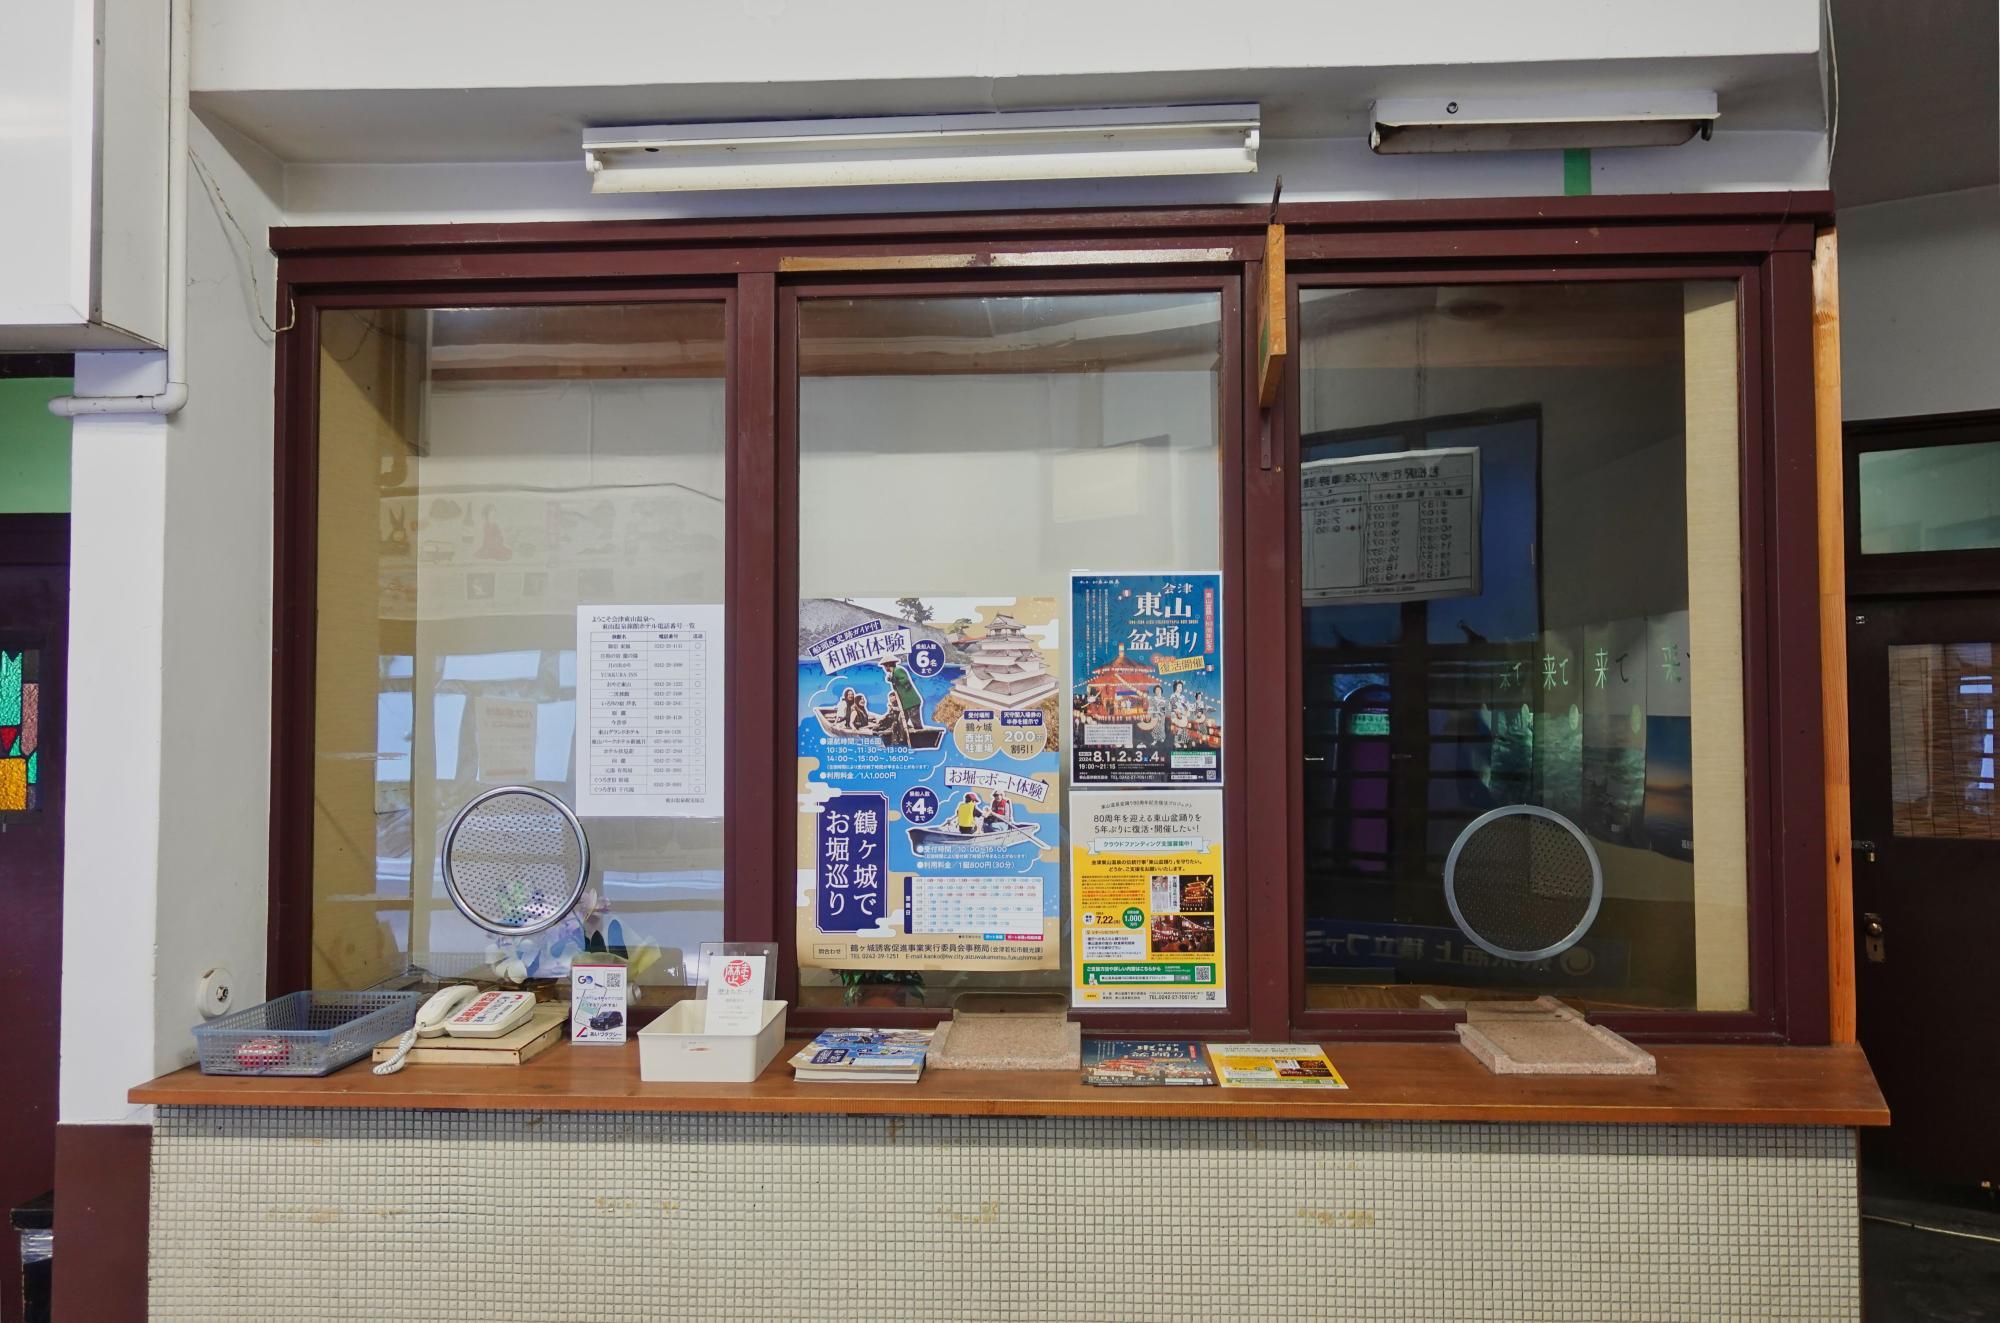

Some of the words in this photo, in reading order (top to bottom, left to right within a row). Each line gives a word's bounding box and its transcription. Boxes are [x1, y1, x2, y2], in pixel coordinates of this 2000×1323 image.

[1162, 583, 1194, 594] 会津
[1134, 592, 1192, 618] 東山
[827, 632, 906, 669] 和船体験
[1127, 625, 1198, 653] 盆踊り
[1542, 652, 1569, 691] 来て
[965, 744, 994, 753] 駐車場
[949, 768, 1044, 799] お堀でボート体験
[1093, 814, 1202, 823] 80周年を迎える東山盆踊りを
[825, 810, 850, 916] お堀巡り
[853, 809, 878, 916] 鶴ヶ城で
